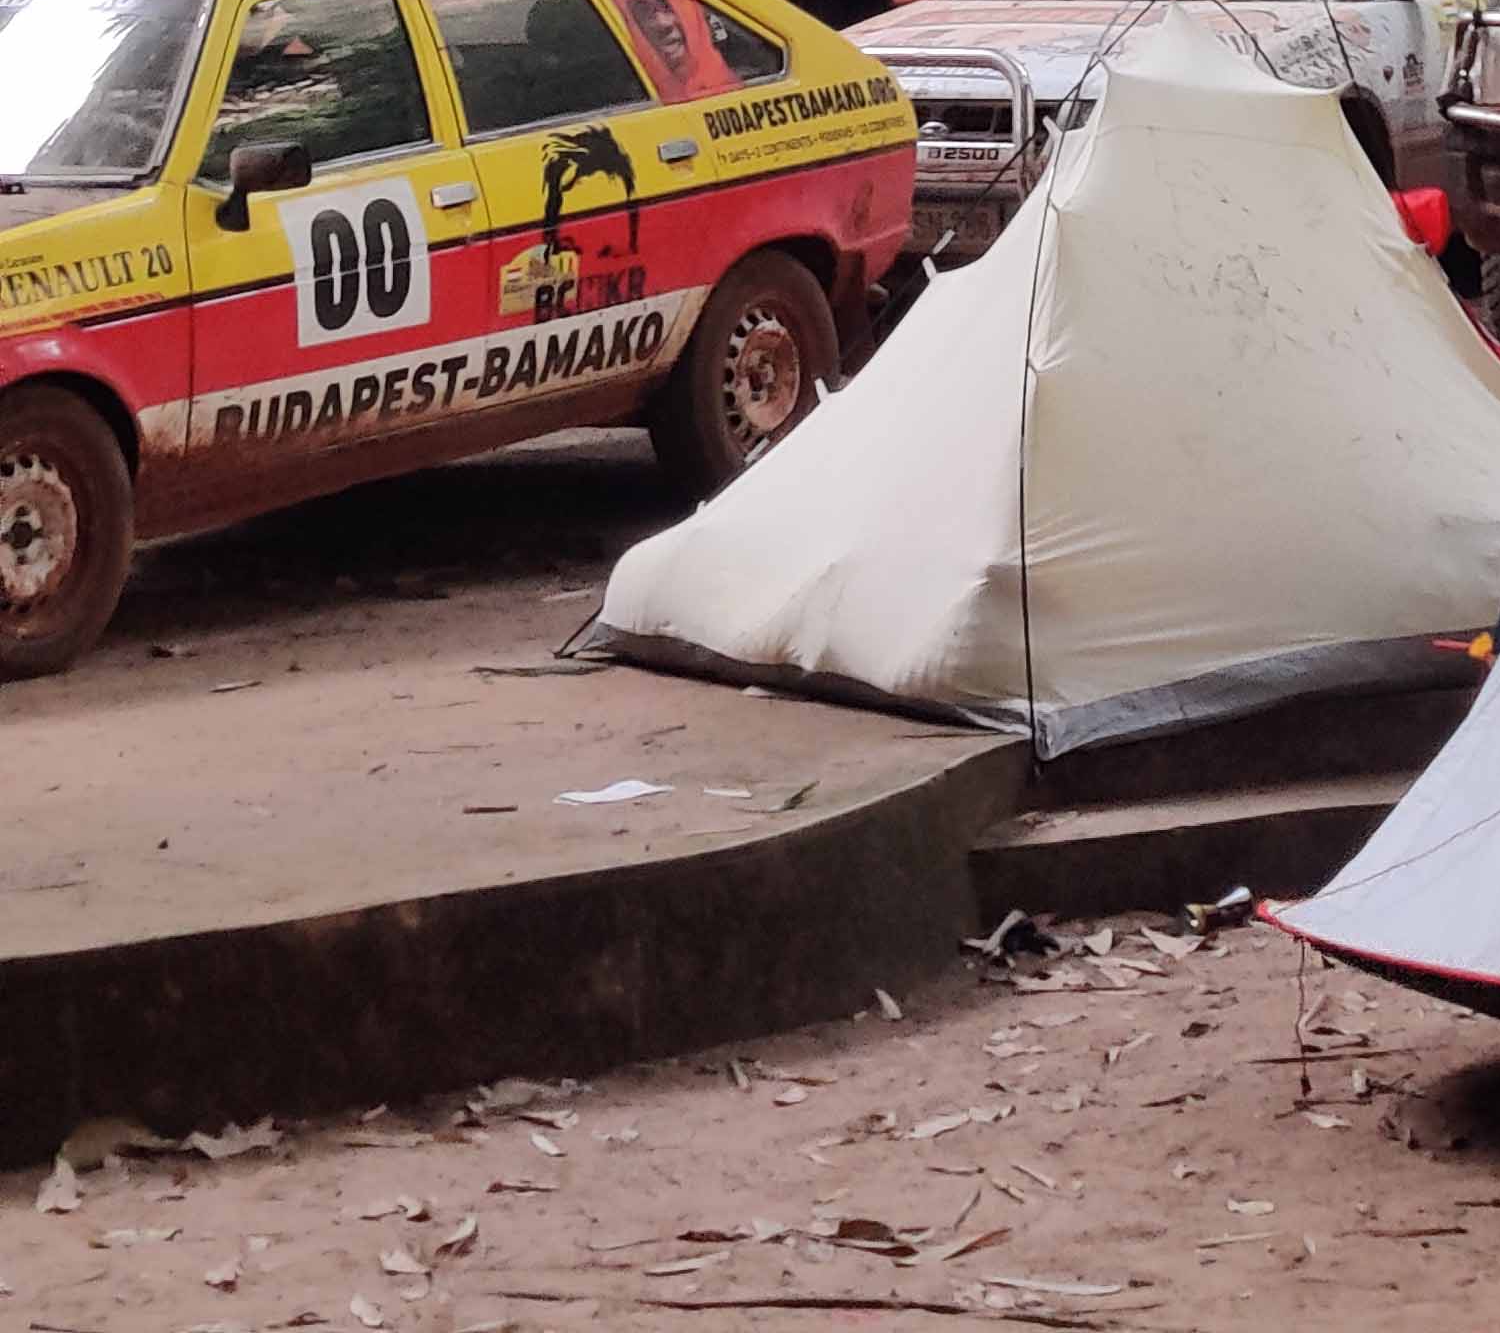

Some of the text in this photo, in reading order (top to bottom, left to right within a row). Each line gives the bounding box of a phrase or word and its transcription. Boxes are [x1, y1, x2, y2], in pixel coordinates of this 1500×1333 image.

[703, 75, 899, 140] BUDAPESTBAMAKO.ORG
[140, 243, 174, 278] 20
[312, 197, 411, 331] 00
[214, 309, 666, 445] BUDAPEST-BAMAKO
